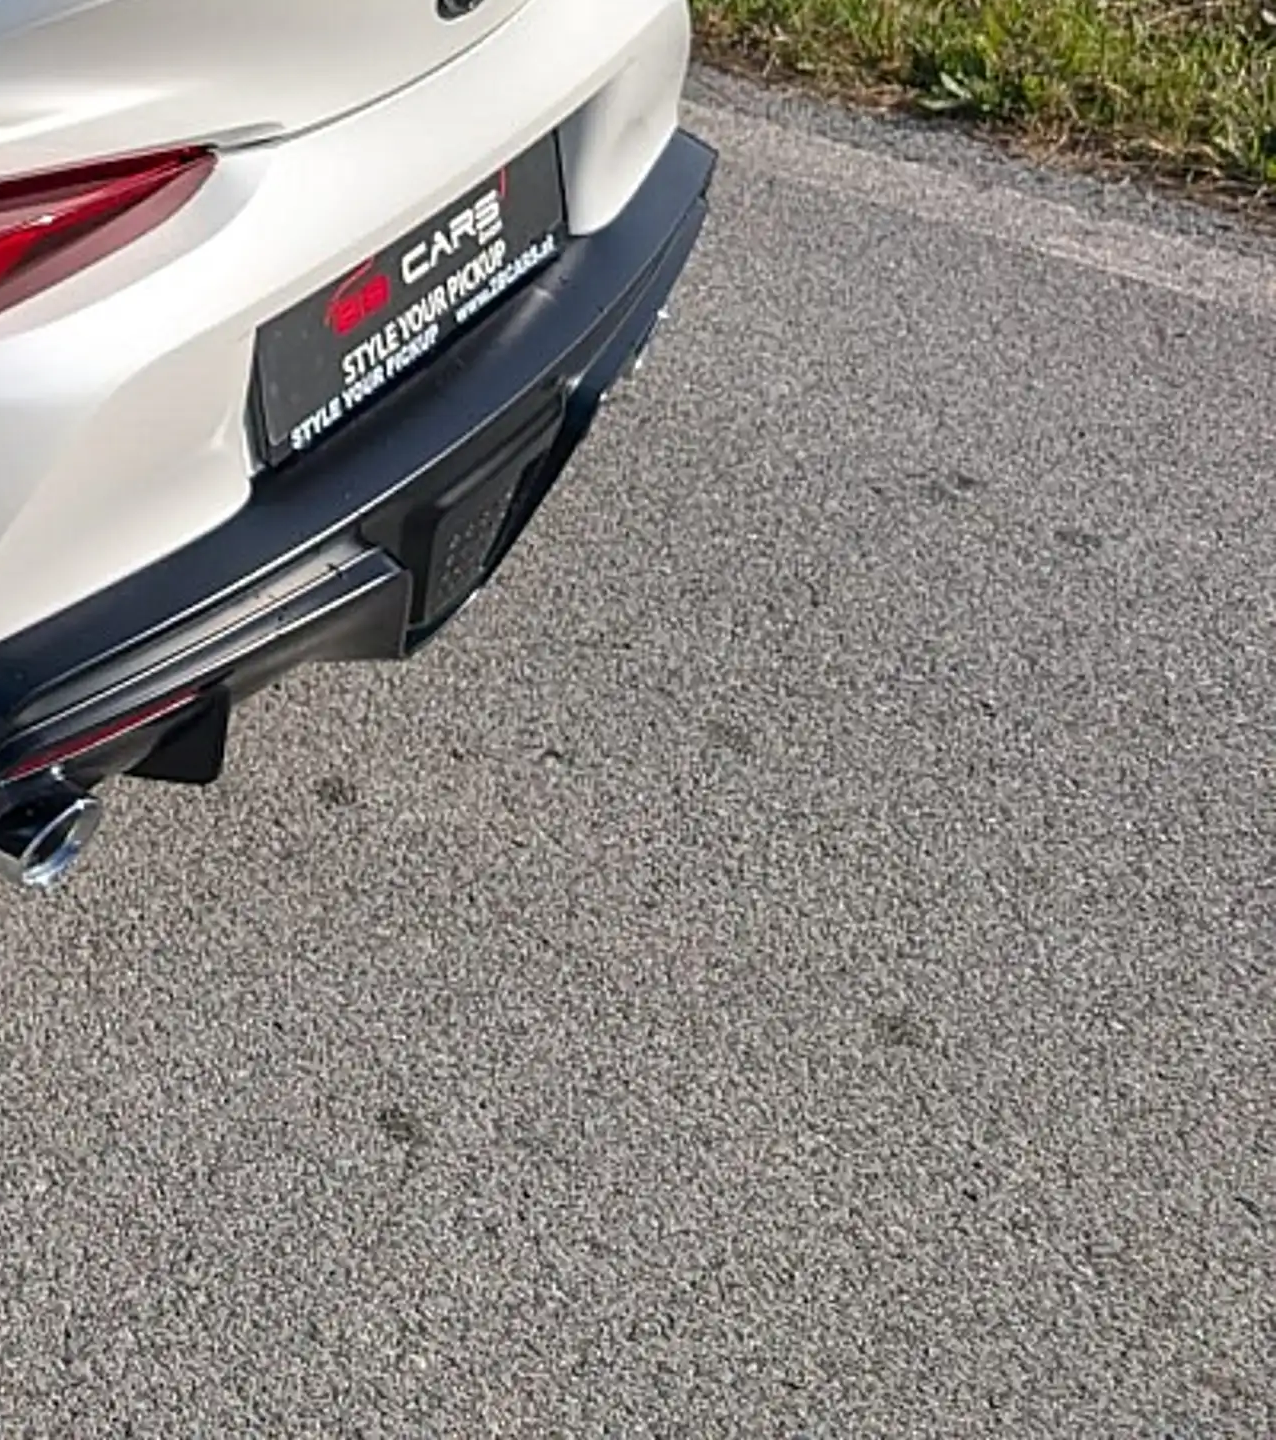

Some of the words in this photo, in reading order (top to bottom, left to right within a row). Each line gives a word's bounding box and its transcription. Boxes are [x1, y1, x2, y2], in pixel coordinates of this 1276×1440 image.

[402, 189, 503, 284] CARS
[342, 321, 400, 385] STYLE
[396, 284, 449, 340] YOUR
[447, 238, 506, 305] PICKUP
[289, 396, 343, 450] STYLE
[341, 364, 386, 410] YOUR
[385, 322, 440, 379] PICKUP
